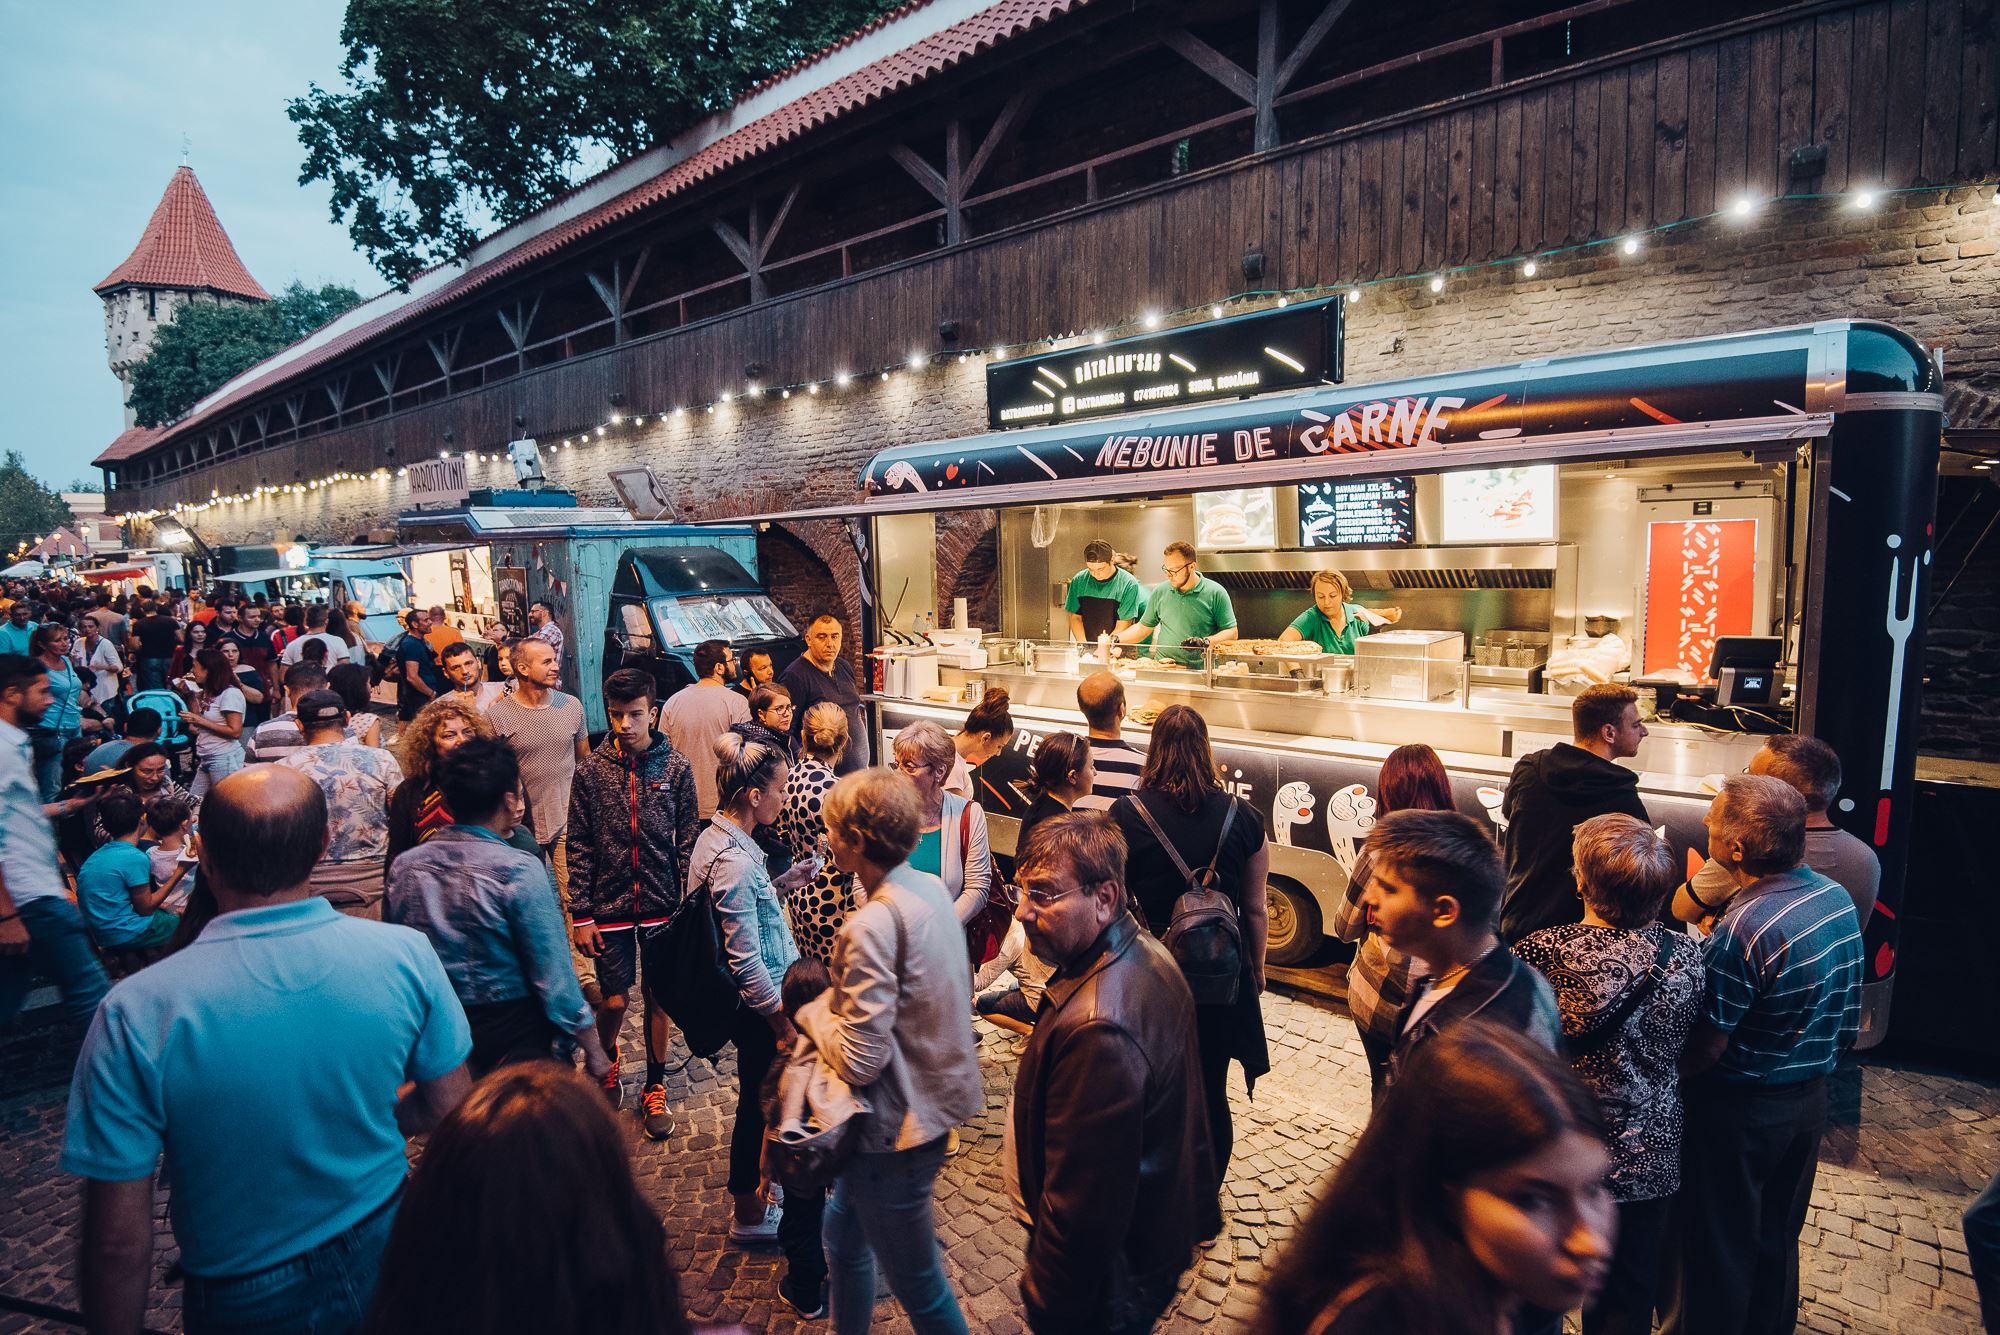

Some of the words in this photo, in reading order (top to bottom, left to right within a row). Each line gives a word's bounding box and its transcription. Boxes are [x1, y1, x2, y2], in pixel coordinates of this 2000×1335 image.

[1217, 371, 1259, 389] ROMÂNIA
[1095, 433, 1218, 468] NEBUNIE
[1234, 427, 1275, 459] DE
[1300, 397, 1466, 454] CARNE
[410, 461, 464, 494] ARROSTICINI
[1335, 484, 1366, 494] BAVARIAN
[1335, 494, 1348, 502] HOT
[1349, 492, 1380, 501] BAVARIAN
[1336, 526, 1365, 535] PREMIUM
[1336, 534, 1362, 543] CARTOFI
